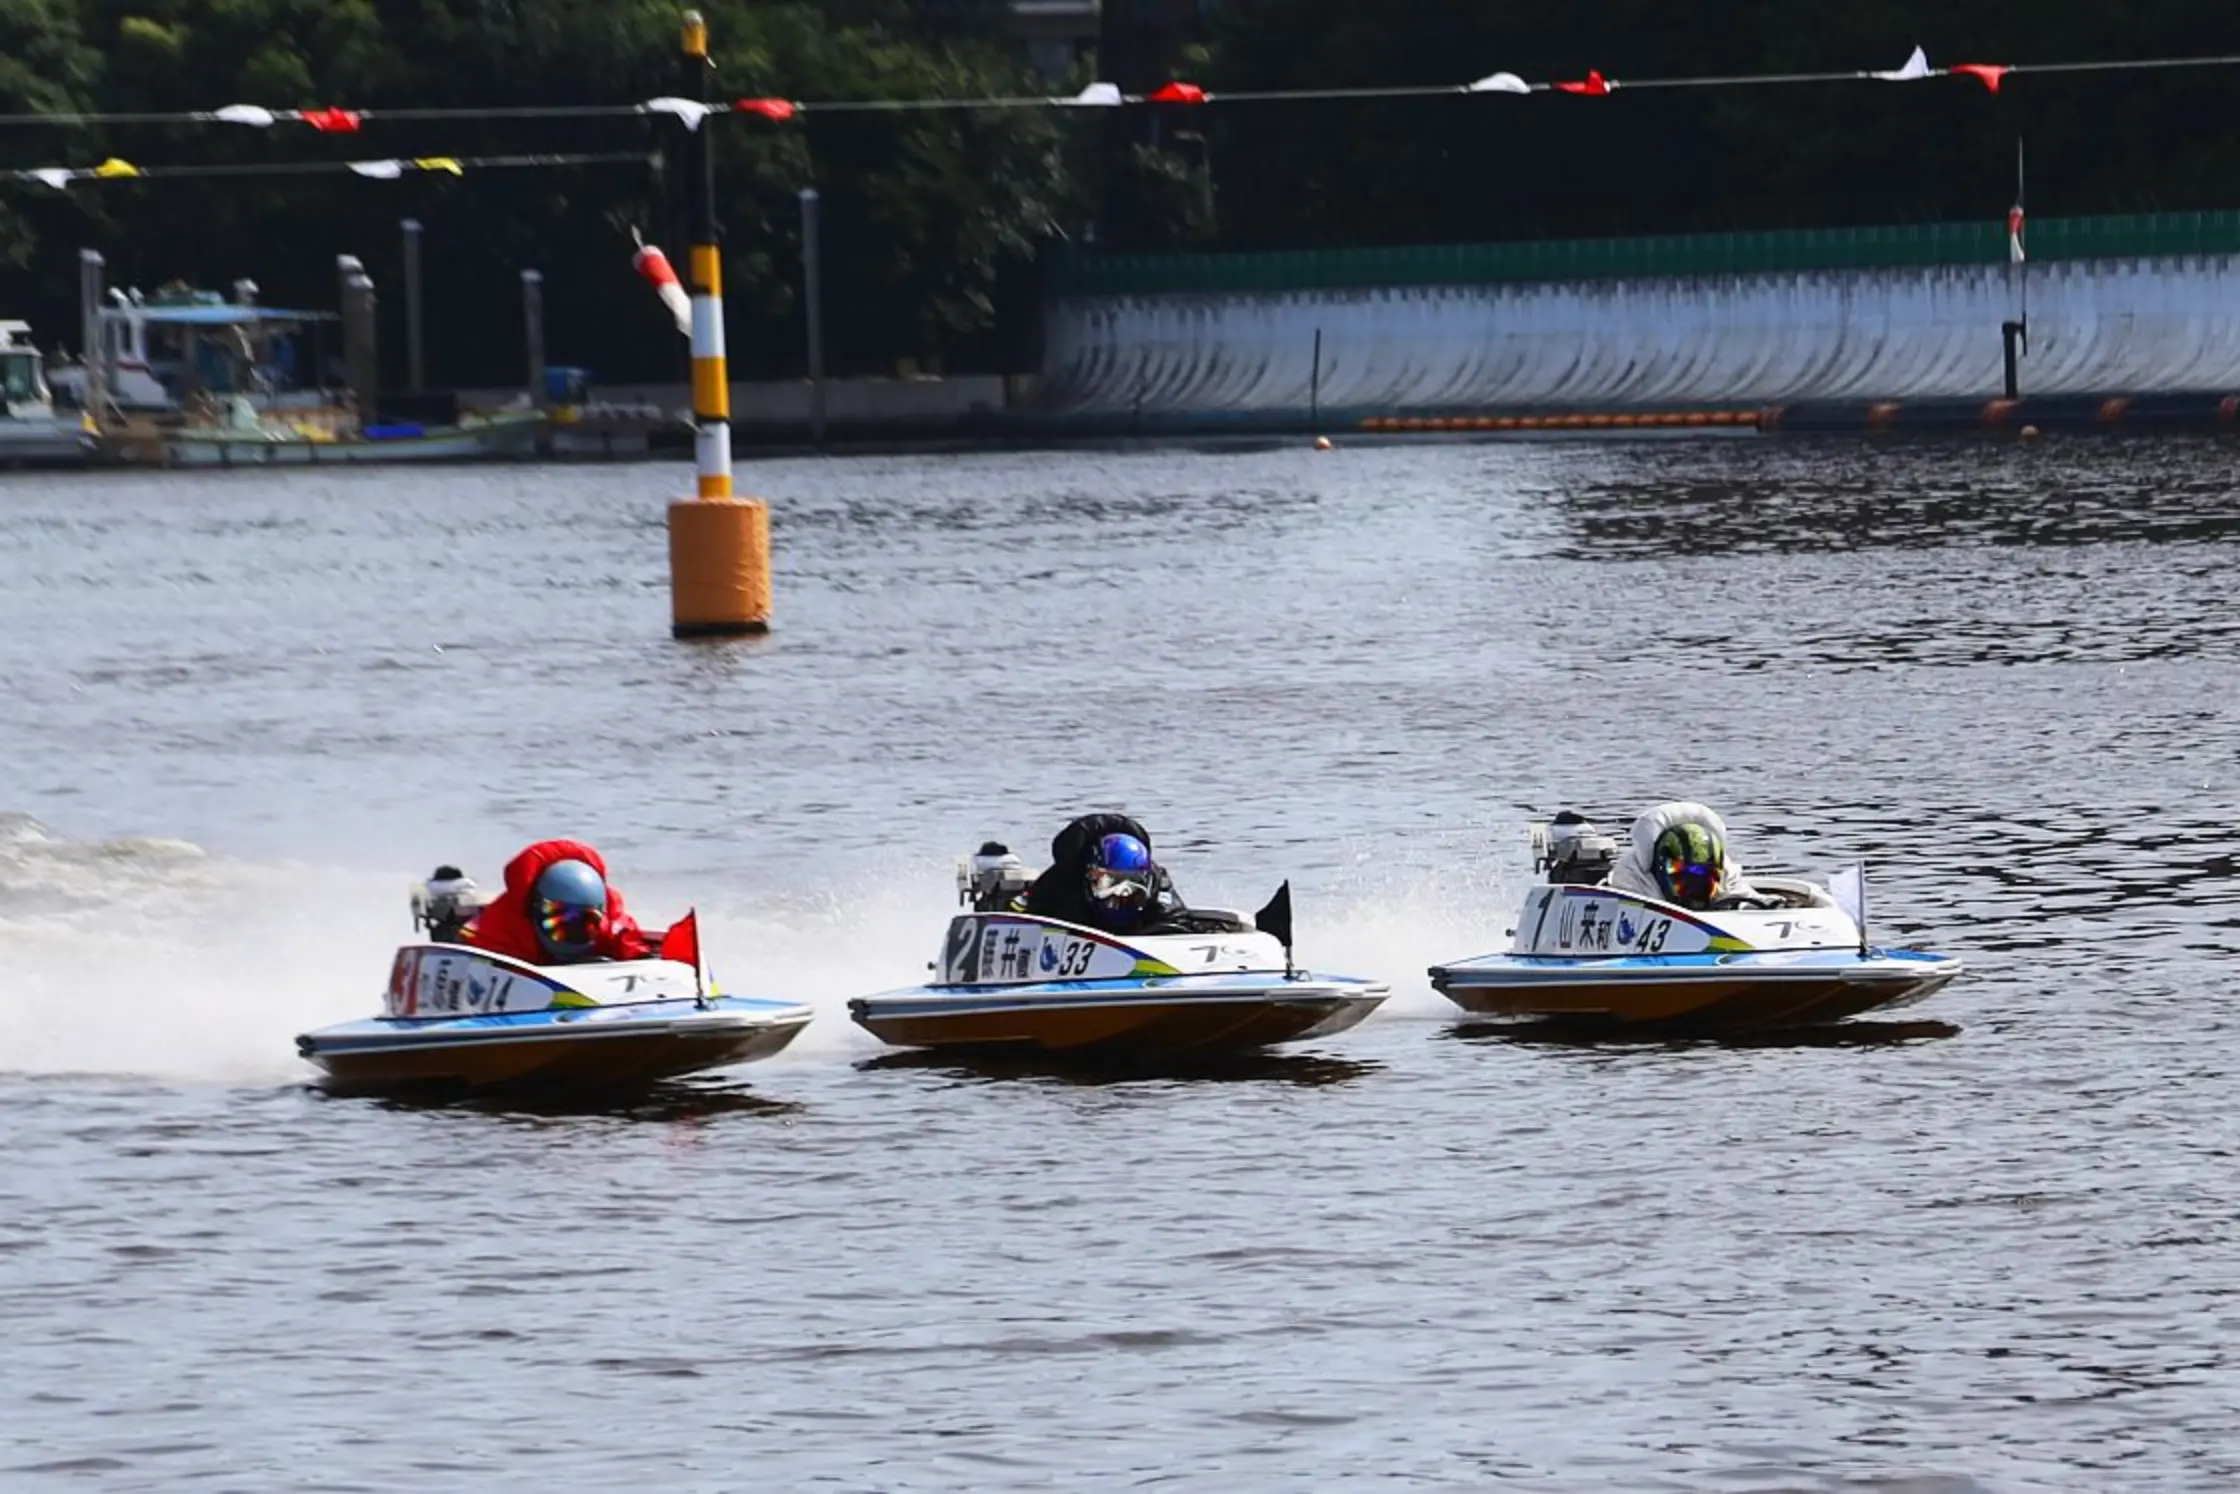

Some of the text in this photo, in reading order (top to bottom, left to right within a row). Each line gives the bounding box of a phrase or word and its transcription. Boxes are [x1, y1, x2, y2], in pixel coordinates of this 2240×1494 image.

[950, 917, 978, 983] 2
[1058, 941, 1097, 976] 33
[1531, 888, 1556, 952] 1
[1636, 918, 1673, 953] 43
